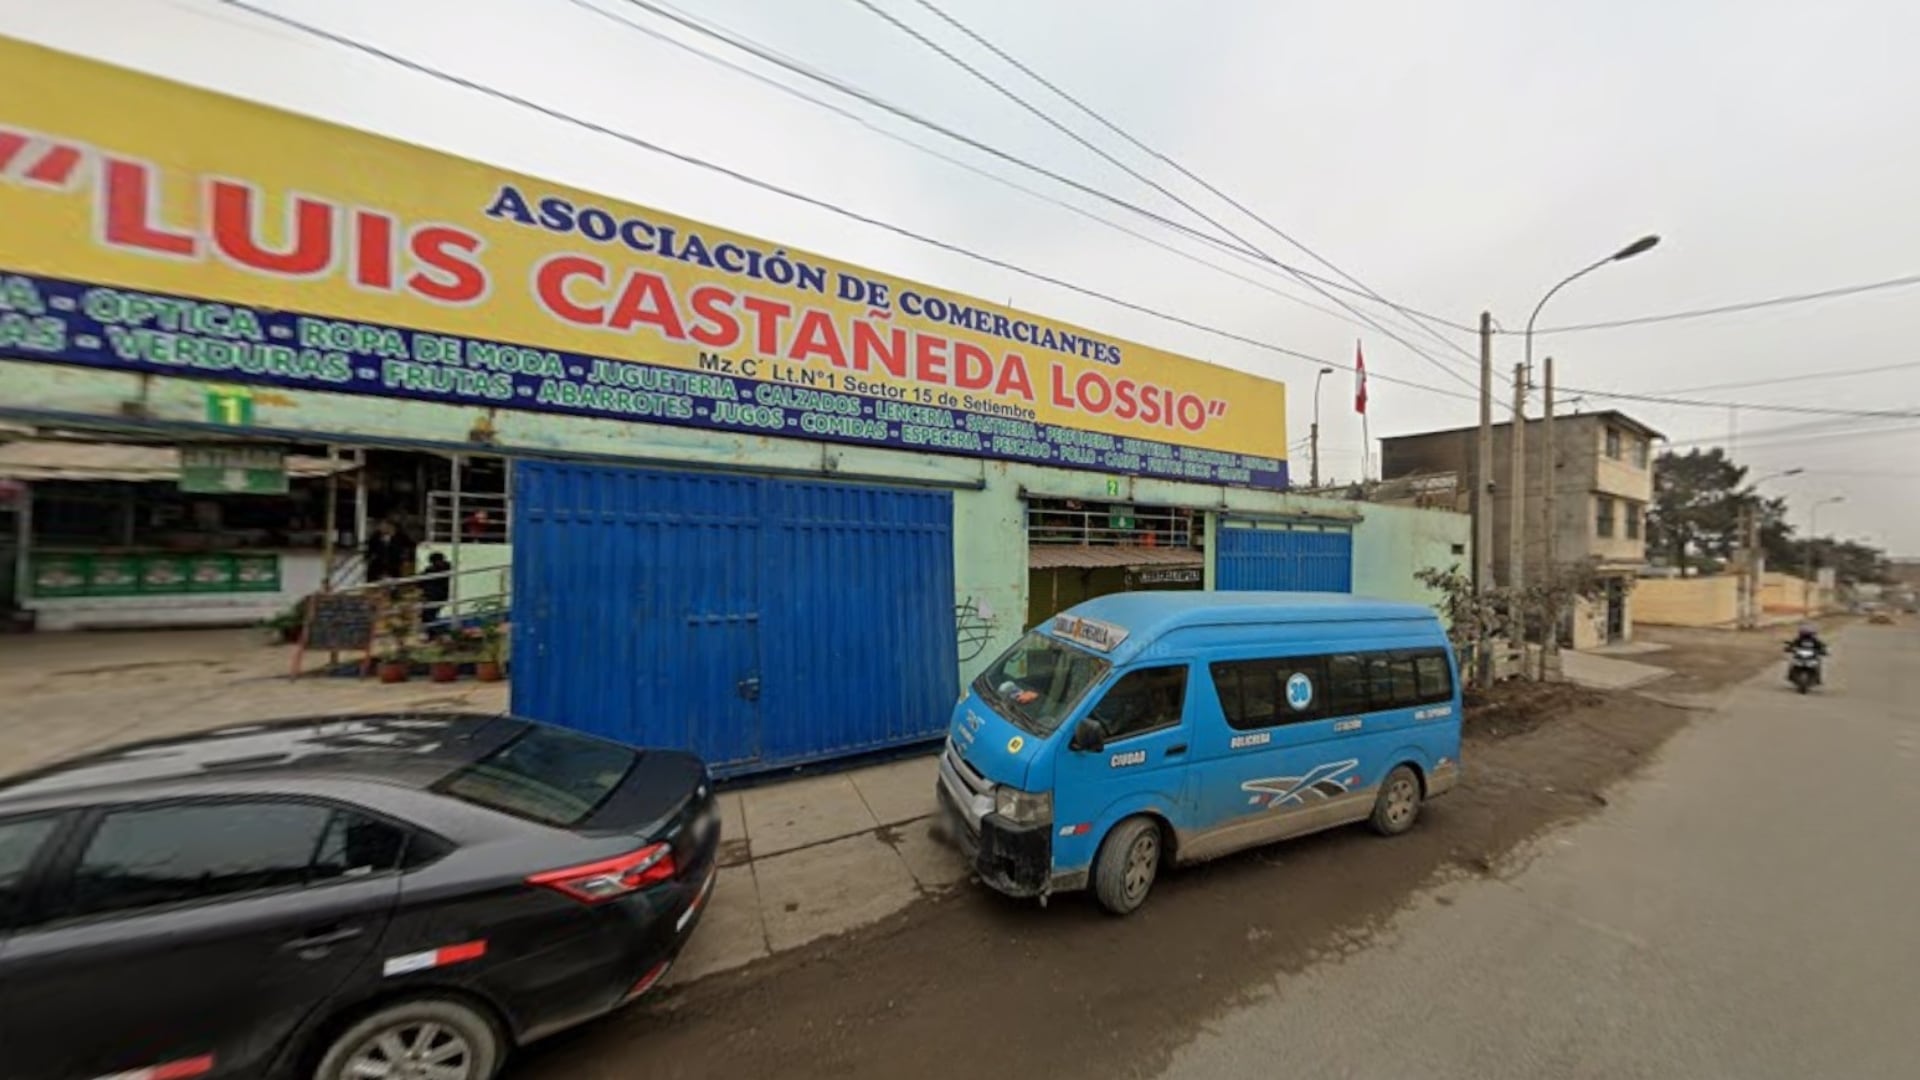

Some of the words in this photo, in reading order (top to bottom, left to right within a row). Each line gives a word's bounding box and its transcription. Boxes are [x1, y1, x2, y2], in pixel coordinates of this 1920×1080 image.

[485, 186, 826, 293] ASOCIACIÓN
[837, 273, 890, 309] DE
[900, 291, 1122, 365] COMERCIANTES
[535, 254, 1034, 402] CASTAÑEDA
[103, 324, 354, 384] VERDURAS
[381, 358, 514, 400] FRUTAS
[535, 378, 694, 419] ABARROTES
[710, 400, 785, 430] JUGOS
[800, 412, 889, 441] COMIDAS
[900, 423, 983, 451] ESPECERIA
[991, 435, 1051, 460] PESCADO
[1060, 444, 1097, 465] POLLO
[217, 395, 243, 424] 1
[298, 316, 409, 360] ROPA
[413, 333, 464, 364] DE
[465, 339, 566, 380] MODA
[587, 358, 738, 400] JUGUETERIA
[755, 383, 861, 416] CALZADOS
[875, 400, 954, 429] LENCERIA
[965, 413, 1037, 440] SASTRERIA
[843, 375, 907, 399] Sector
[913, 387, 932, 404] 15
[938, 393, 958, 407] de
[964, 395, 1036, 419] Setiembre
[1109, 480, 1117, 495] 2
[1290, 681, 1309, 702] 30
